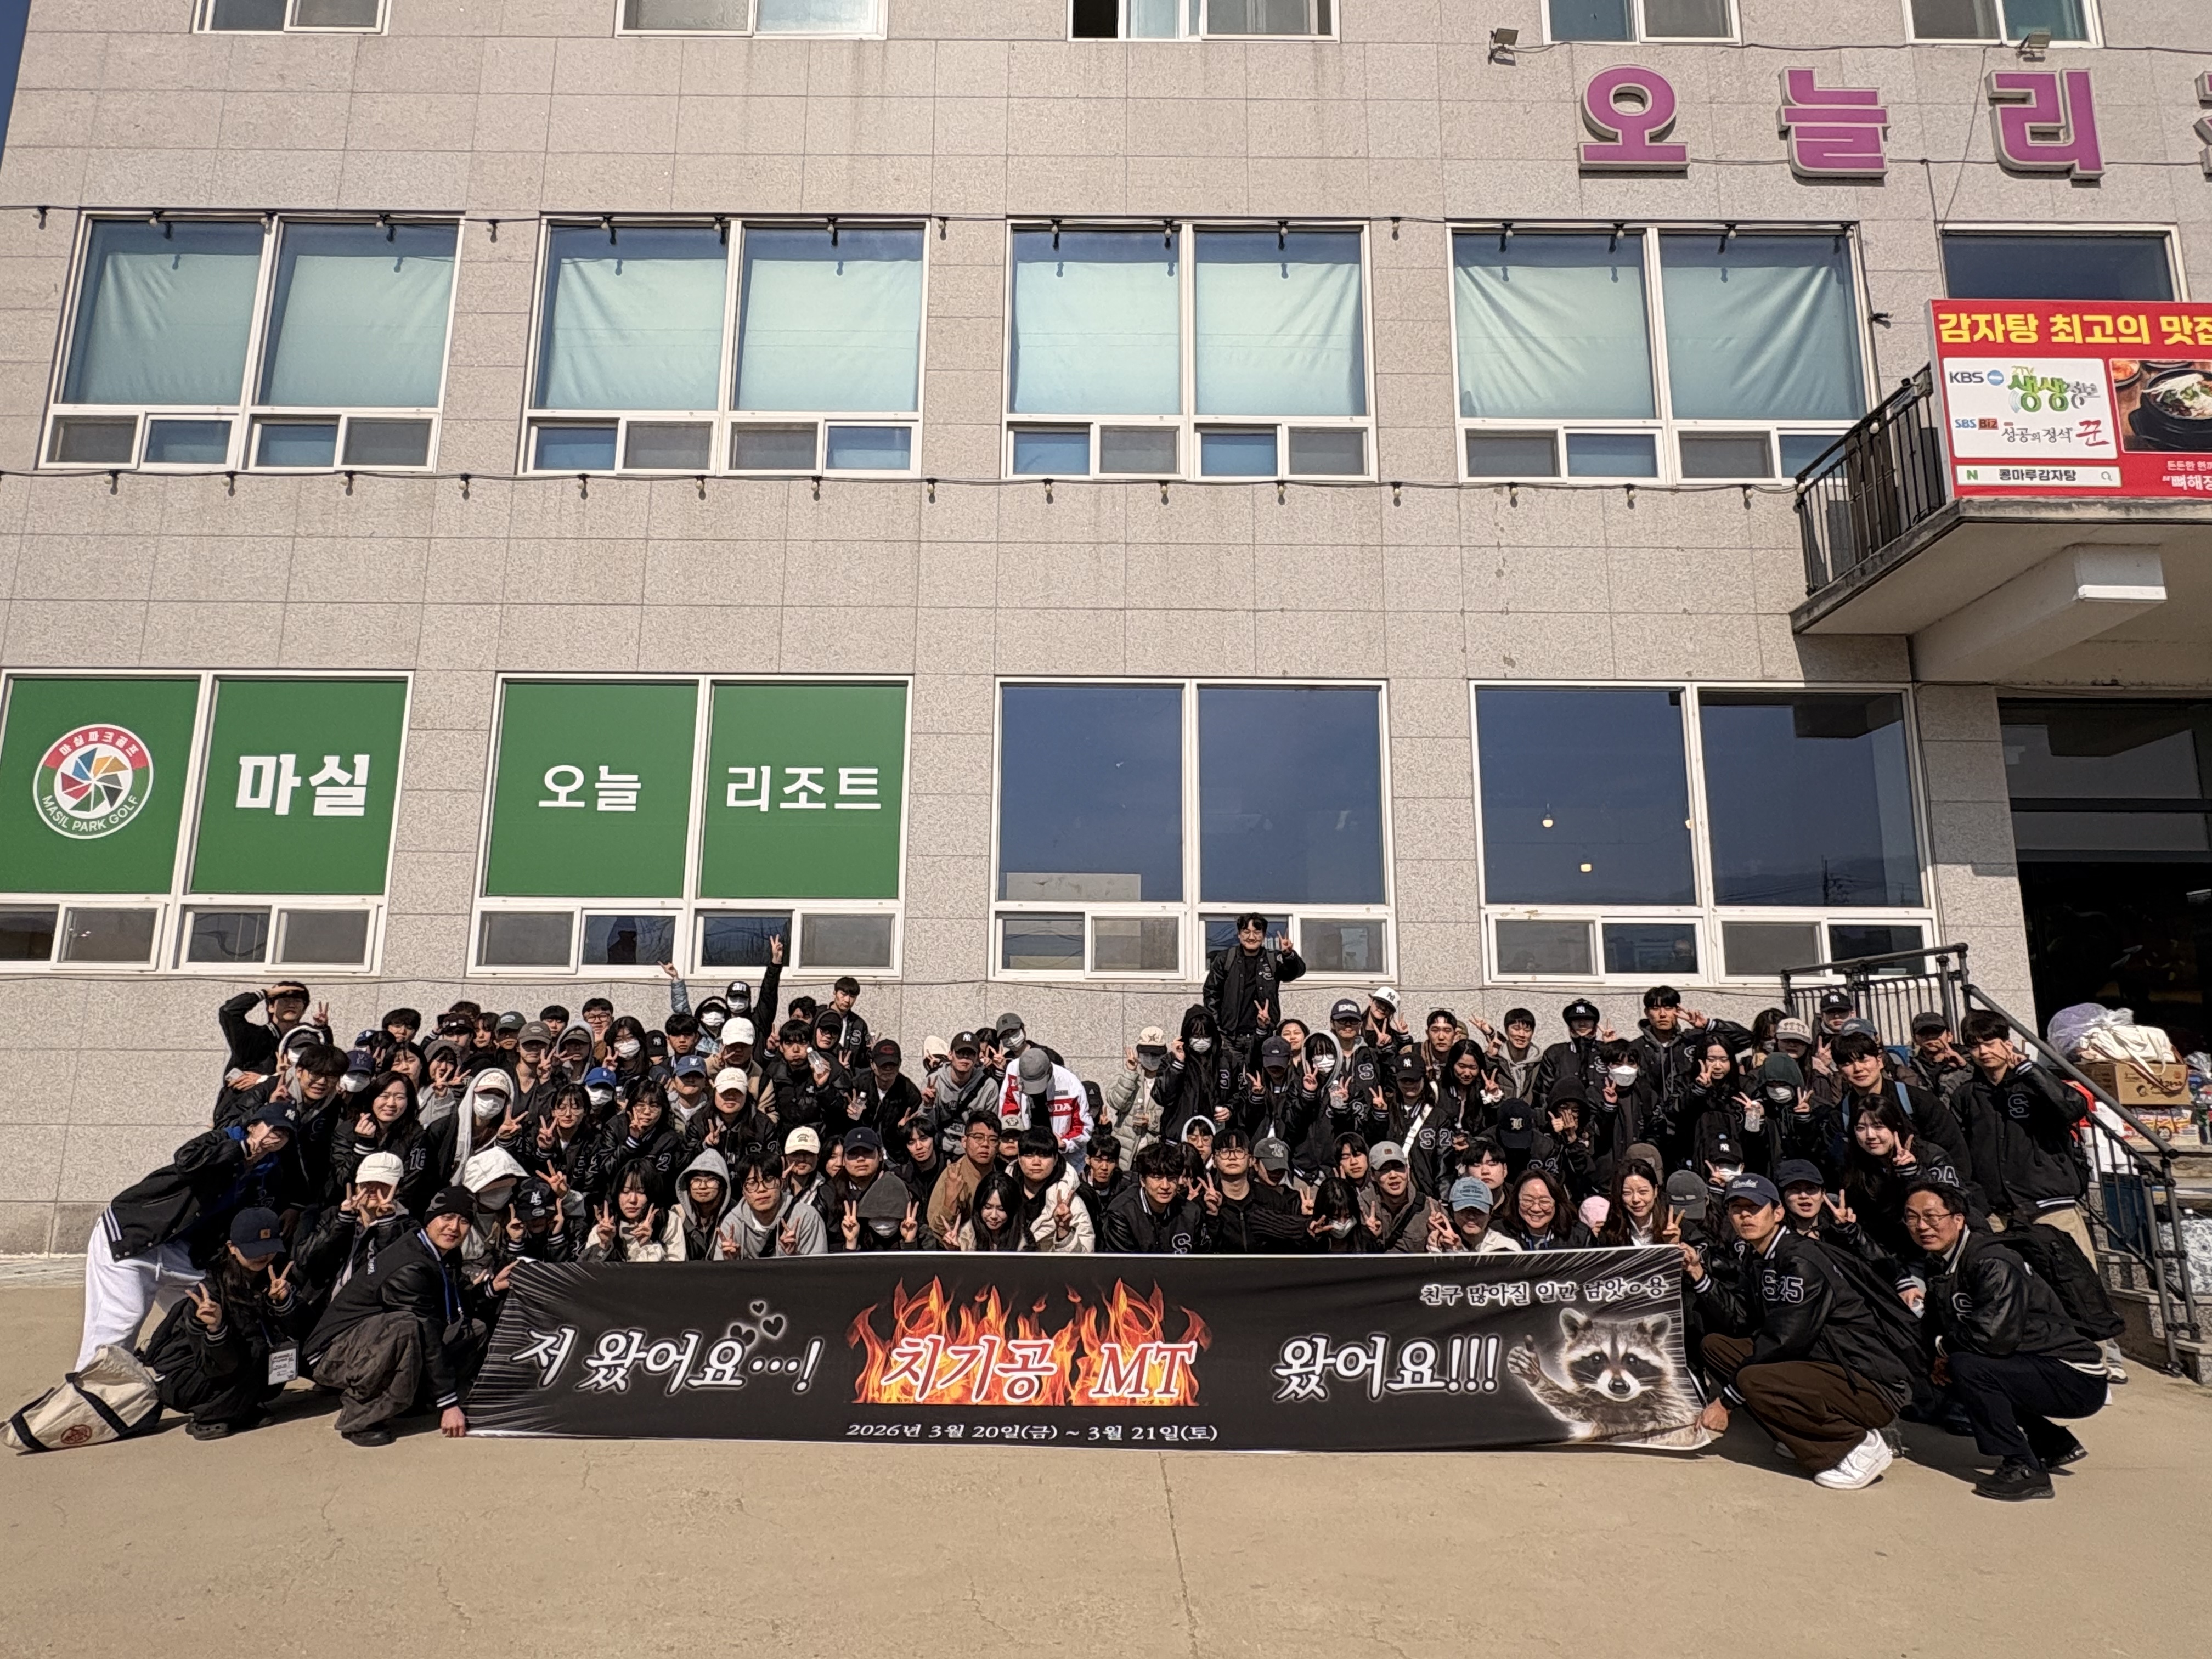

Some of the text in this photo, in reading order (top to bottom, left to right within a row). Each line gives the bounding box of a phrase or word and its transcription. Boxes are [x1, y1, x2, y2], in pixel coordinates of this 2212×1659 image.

[1938, 313, 2039, 343] 감자탕
[2050, 314, 2151, 345] 최고의
[1949, 372, 1984, 383] KBS
[1955, 419, 1977, 428] SBS
[2076, 419, 2111, 447] 꾼
[1966, 469, 1978, 481] N
[236, 754, 370, 816] 마실
[539, 765, 881, 812] 오늘 리조트
[42, 794, 138, 832] MASIL PARK GOLF
[1358, 1063, 1375, 1080] S
[2008, 1094, 2030, 1118] S
[1419, 1128, 1436, 1150] S
[1420, 1283, 1463, 1306] 친구
[1467, 1282, 1530, 1306] 많아질
[1535, 1281, 1577, 1304] 일만
[510, 1325, 577, 1388] 저
[881, 1335, 1198, 1403] 치기공 MT
[1273, 1334, 1500, 1400] 왔어요!!!
[845, 1423, 921, 1438] 2026년
[928, 1424, 963, 1438] 3월
[972, 1424, 1058, 1440] 20일(금)
[1087, 1425, 1123, 1441] 3월
[1131, 1425, 1218, 1442] 21일(토)
